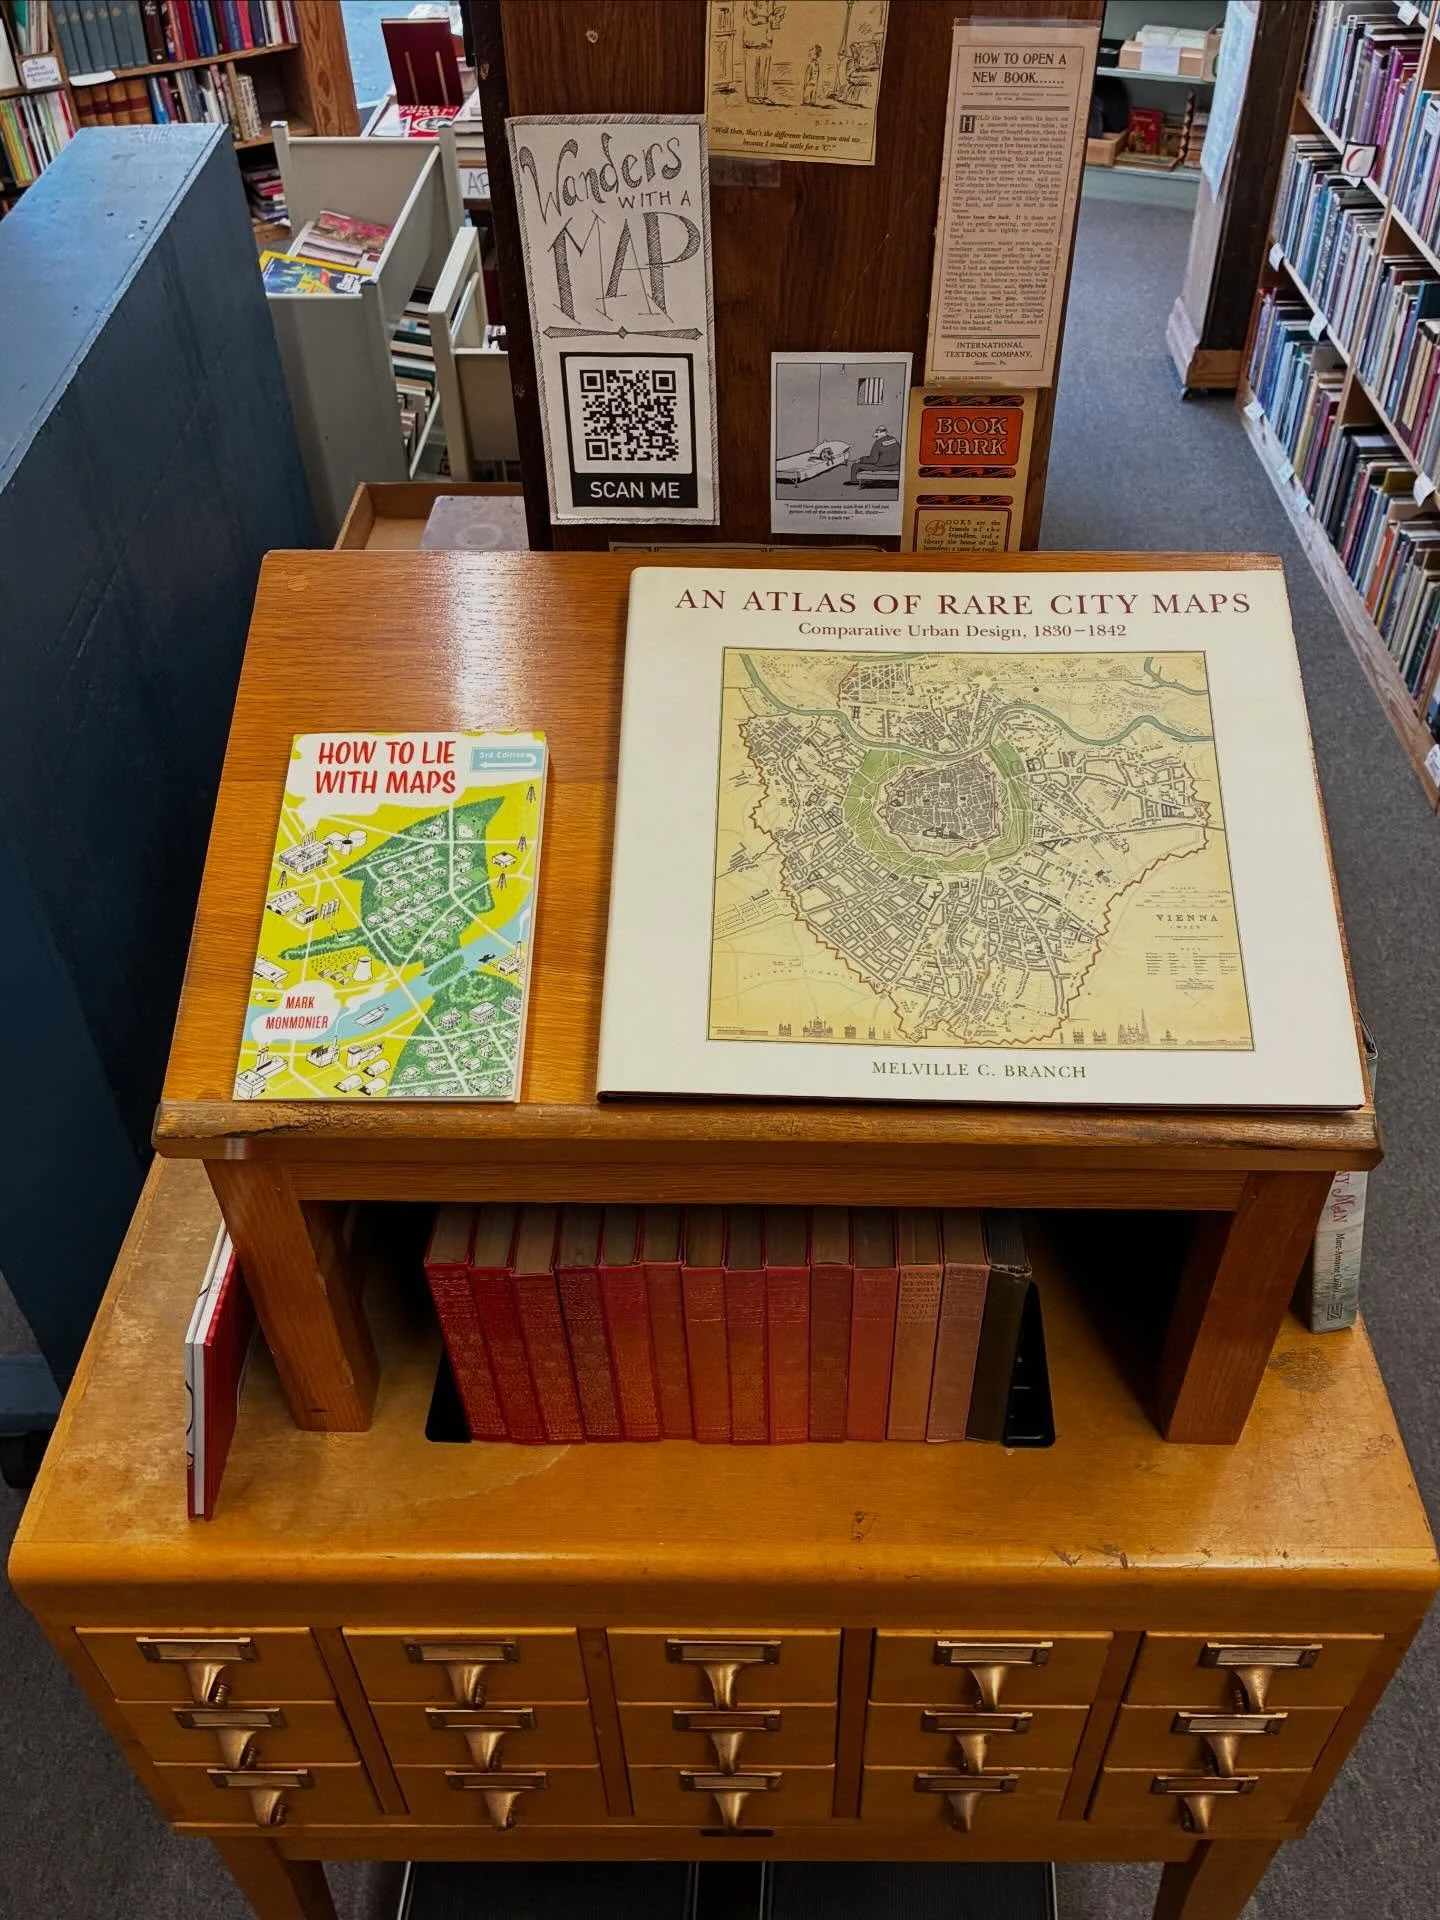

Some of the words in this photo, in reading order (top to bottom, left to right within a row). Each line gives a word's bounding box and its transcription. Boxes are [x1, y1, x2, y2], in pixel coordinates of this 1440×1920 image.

[974, 53, 1000, 65] HOW
[1004, 53, 1019, 65] TO
[1023, 53, 1054, 65] OPEN
[1058, 54, 1067, 65] A
[972, 72, 997, 83] NEW
[519, 132, 682, 224] Wanders
[618, 190, 671, 208] WITH
[680, 190, 691, 206] A
[547, 209, 701, 325] MAP
[935, 417, 1008, 435] BOOK
[933, 438, 1007, 456] MARK
[590, 481, 645, 499] SCAN
[651, 482, 680, 499] ME
[674, 590, 724, 611] AN
[742, 591, 857, 614] ATLAS
[872, 593, 922, 615] OF
[938, 594, 1033, 616] RARE
[1050, 594, 1139, 615] CITY
[1152, 593, 1251, 615] MAPS
[798, 622, 902, 639] Comparative
[908, 624, 960, 637] Urban
[966, 624, 1027, 640] Design,
[318, 740, 377, 764] HOW
[385, 741, 415, 764] TO
[421, 740, 456, 764] LIE
[315, 770, 378, 794] WITH
[385, 770, 456, 794] MAPS
[1156, 914, 1218, 922] VIENNA
[285, 995, 314, 1009] MARK
[265, 1015, 328, 1030] MONMONIER
[872, 1061, 969, 1078] MELVILLE
[976, 1063, 995, 1078] C.
[1004, 1064, 1086, 1079] BRANCH
